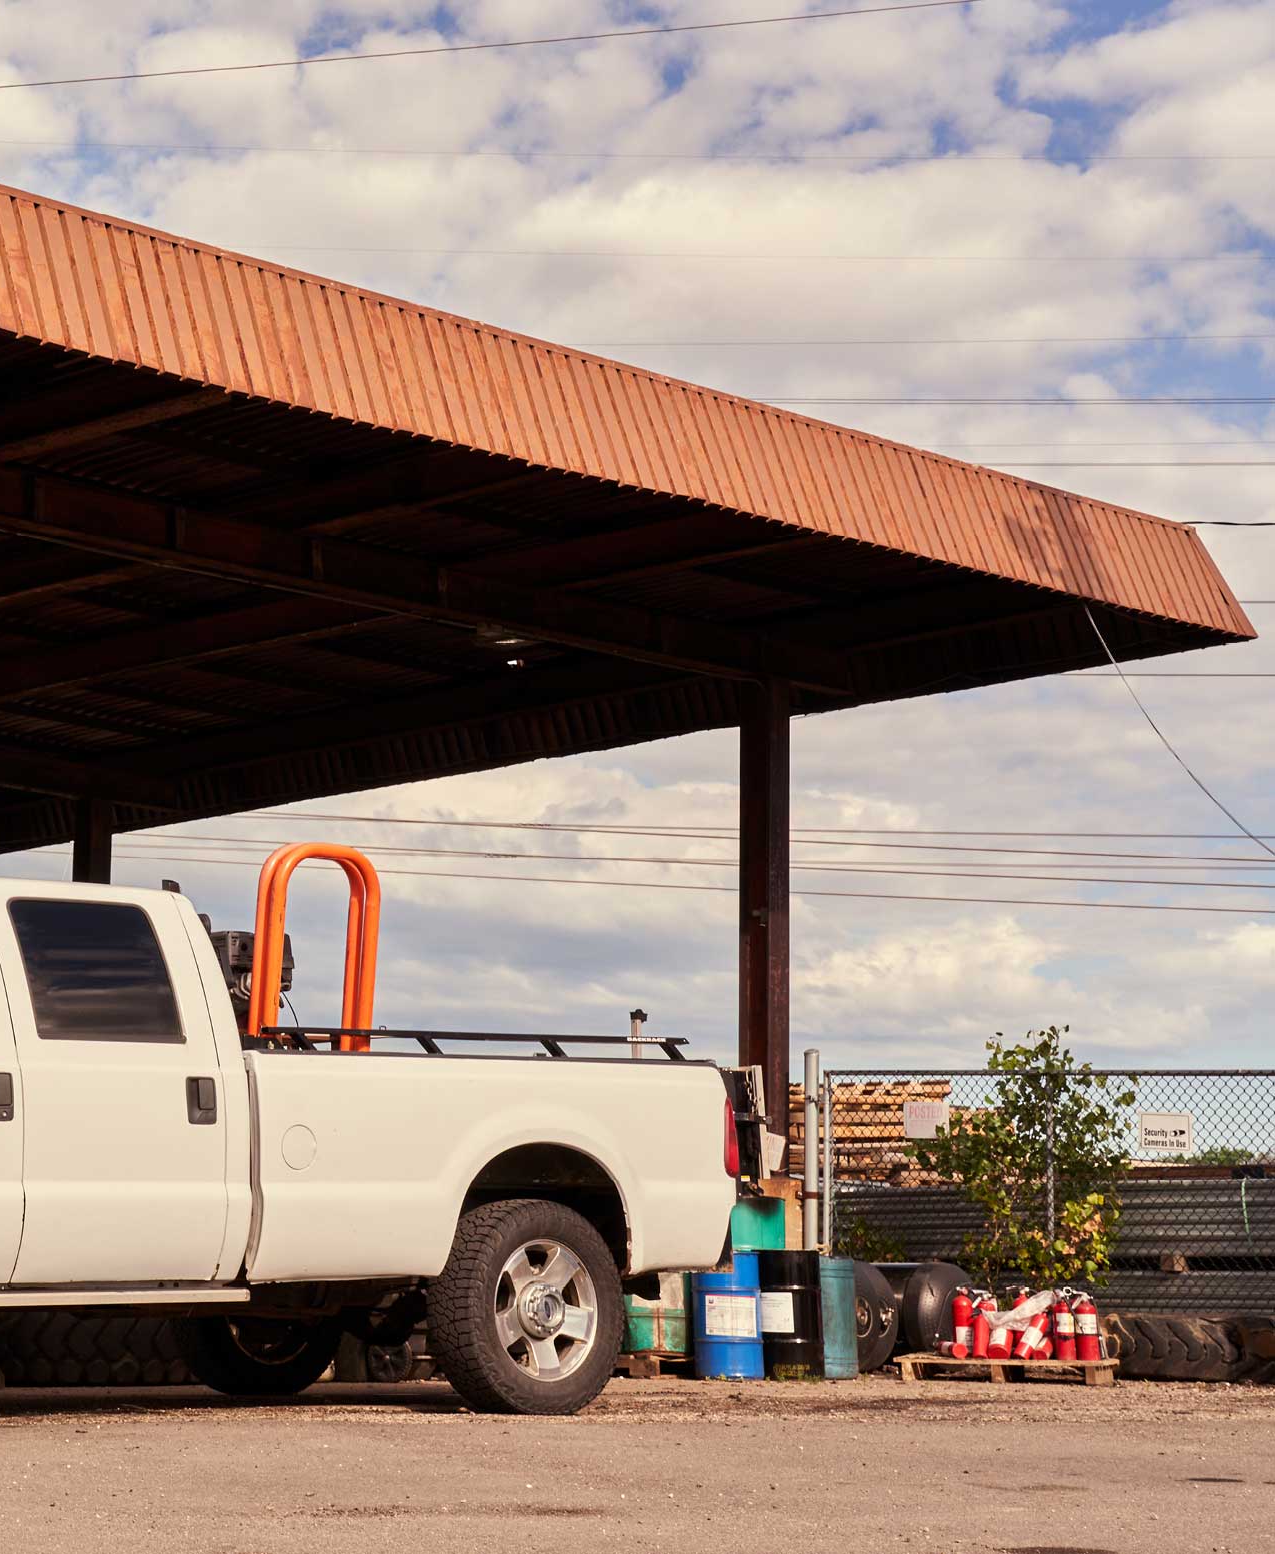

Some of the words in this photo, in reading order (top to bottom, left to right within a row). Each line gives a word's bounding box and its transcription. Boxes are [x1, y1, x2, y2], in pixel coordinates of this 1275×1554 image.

[909, 1104, 943, 1119] POSTED
[1144, 1127, 1168, 1138] Security
[1143, 1137, 1168, 1147] Cameras
[1169, 1139, 1175, 1147] In
[1175, 1139, 1186, 1148] Use
